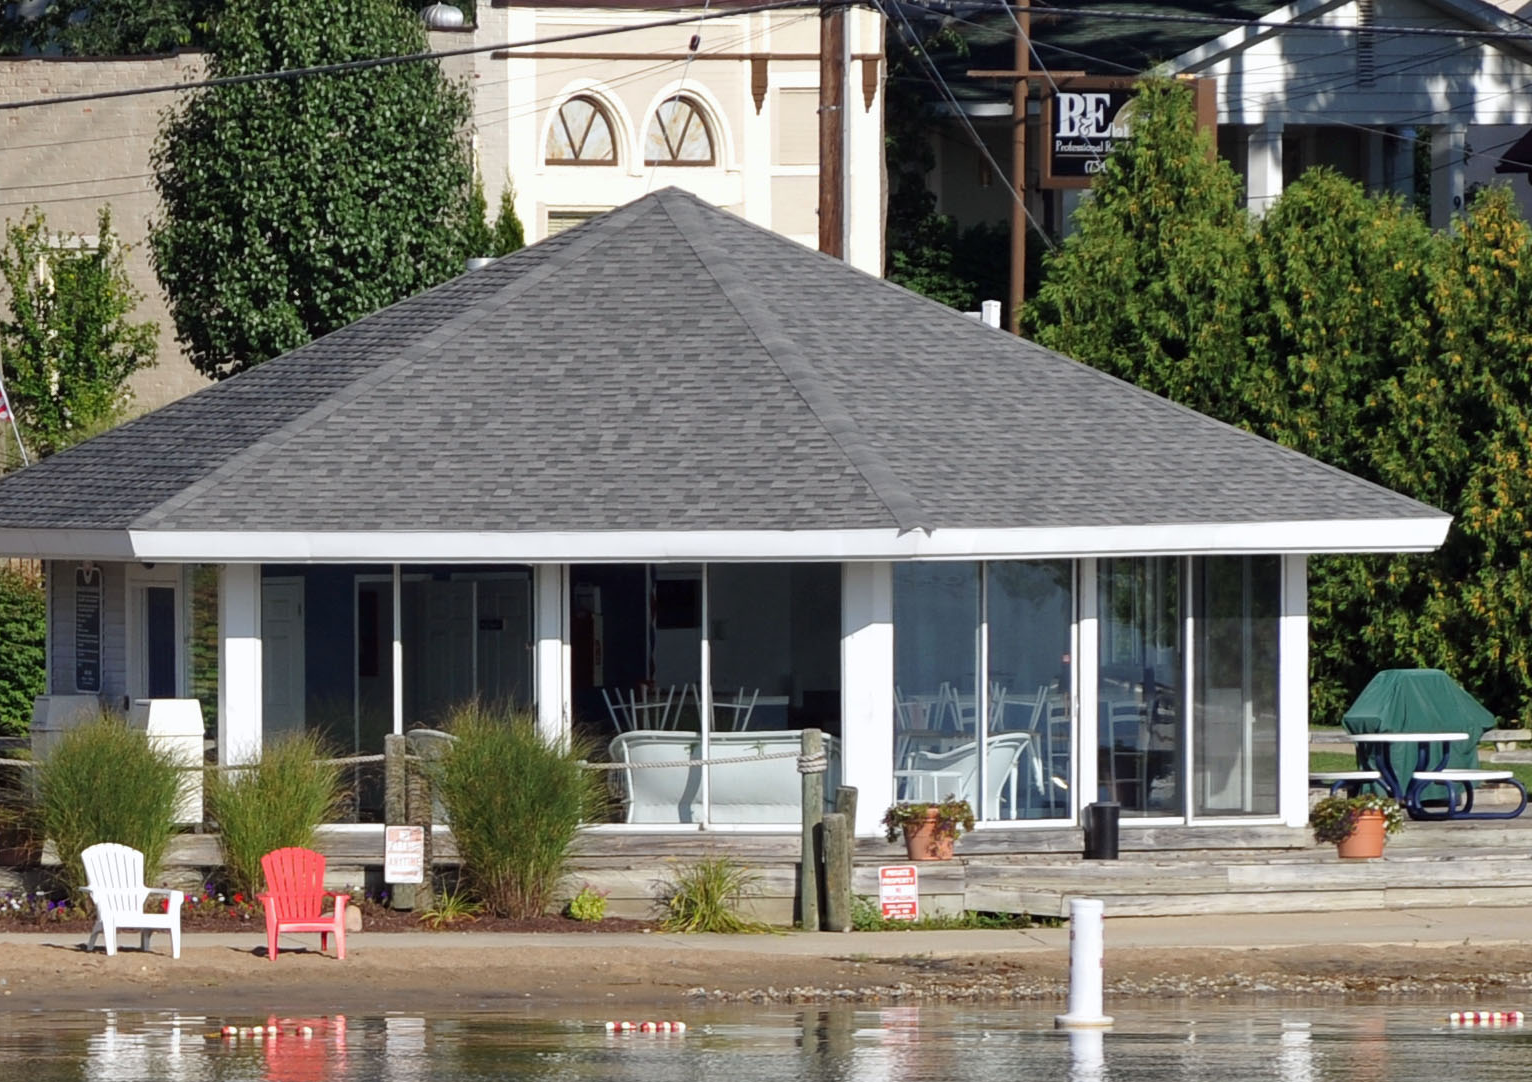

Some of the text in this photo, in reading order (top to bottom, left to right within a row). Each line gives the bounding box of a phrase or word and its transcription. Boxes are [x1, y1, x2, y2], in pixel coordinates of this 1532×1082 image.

[1055, 93, 1111, 137] B&E
[1055, 139, 1103, 153] Professional
[882, 877, 914, 885] PROPERTY
